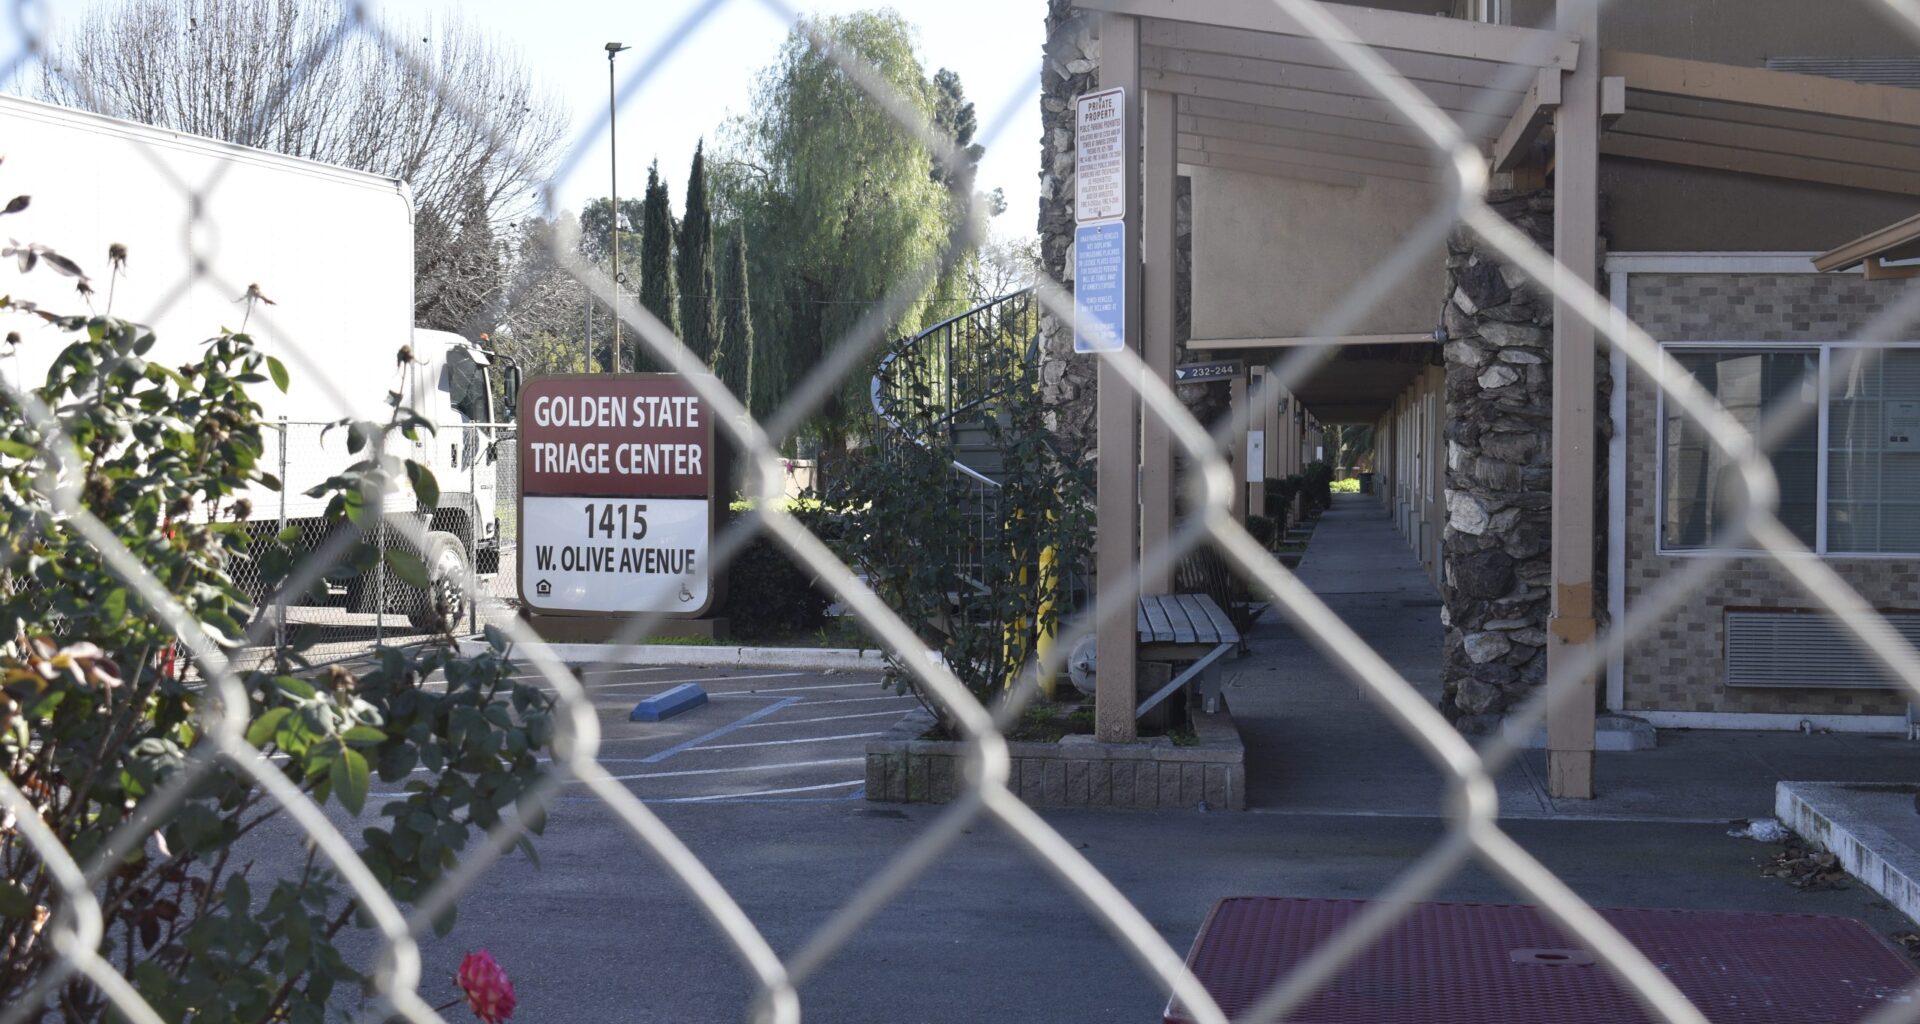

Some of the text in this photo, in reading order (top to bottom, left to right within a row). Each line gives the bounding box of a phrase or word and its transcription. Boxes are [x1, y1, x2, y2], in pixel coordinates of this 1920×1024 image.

[1085, 108, 1115, 122] PROPERTY
[1088, 99, 1112, 111] PRIVATE
[1192, 365, 1233, 377] 232-244
[534, 395, 699, 428] GOLDEN STATE
[531, 442, 702, 475] TRIAGE CENTER
[584, 503, 648, 540] 1415
[536, 545, 696, 575] W. OLIVE AVENUE
